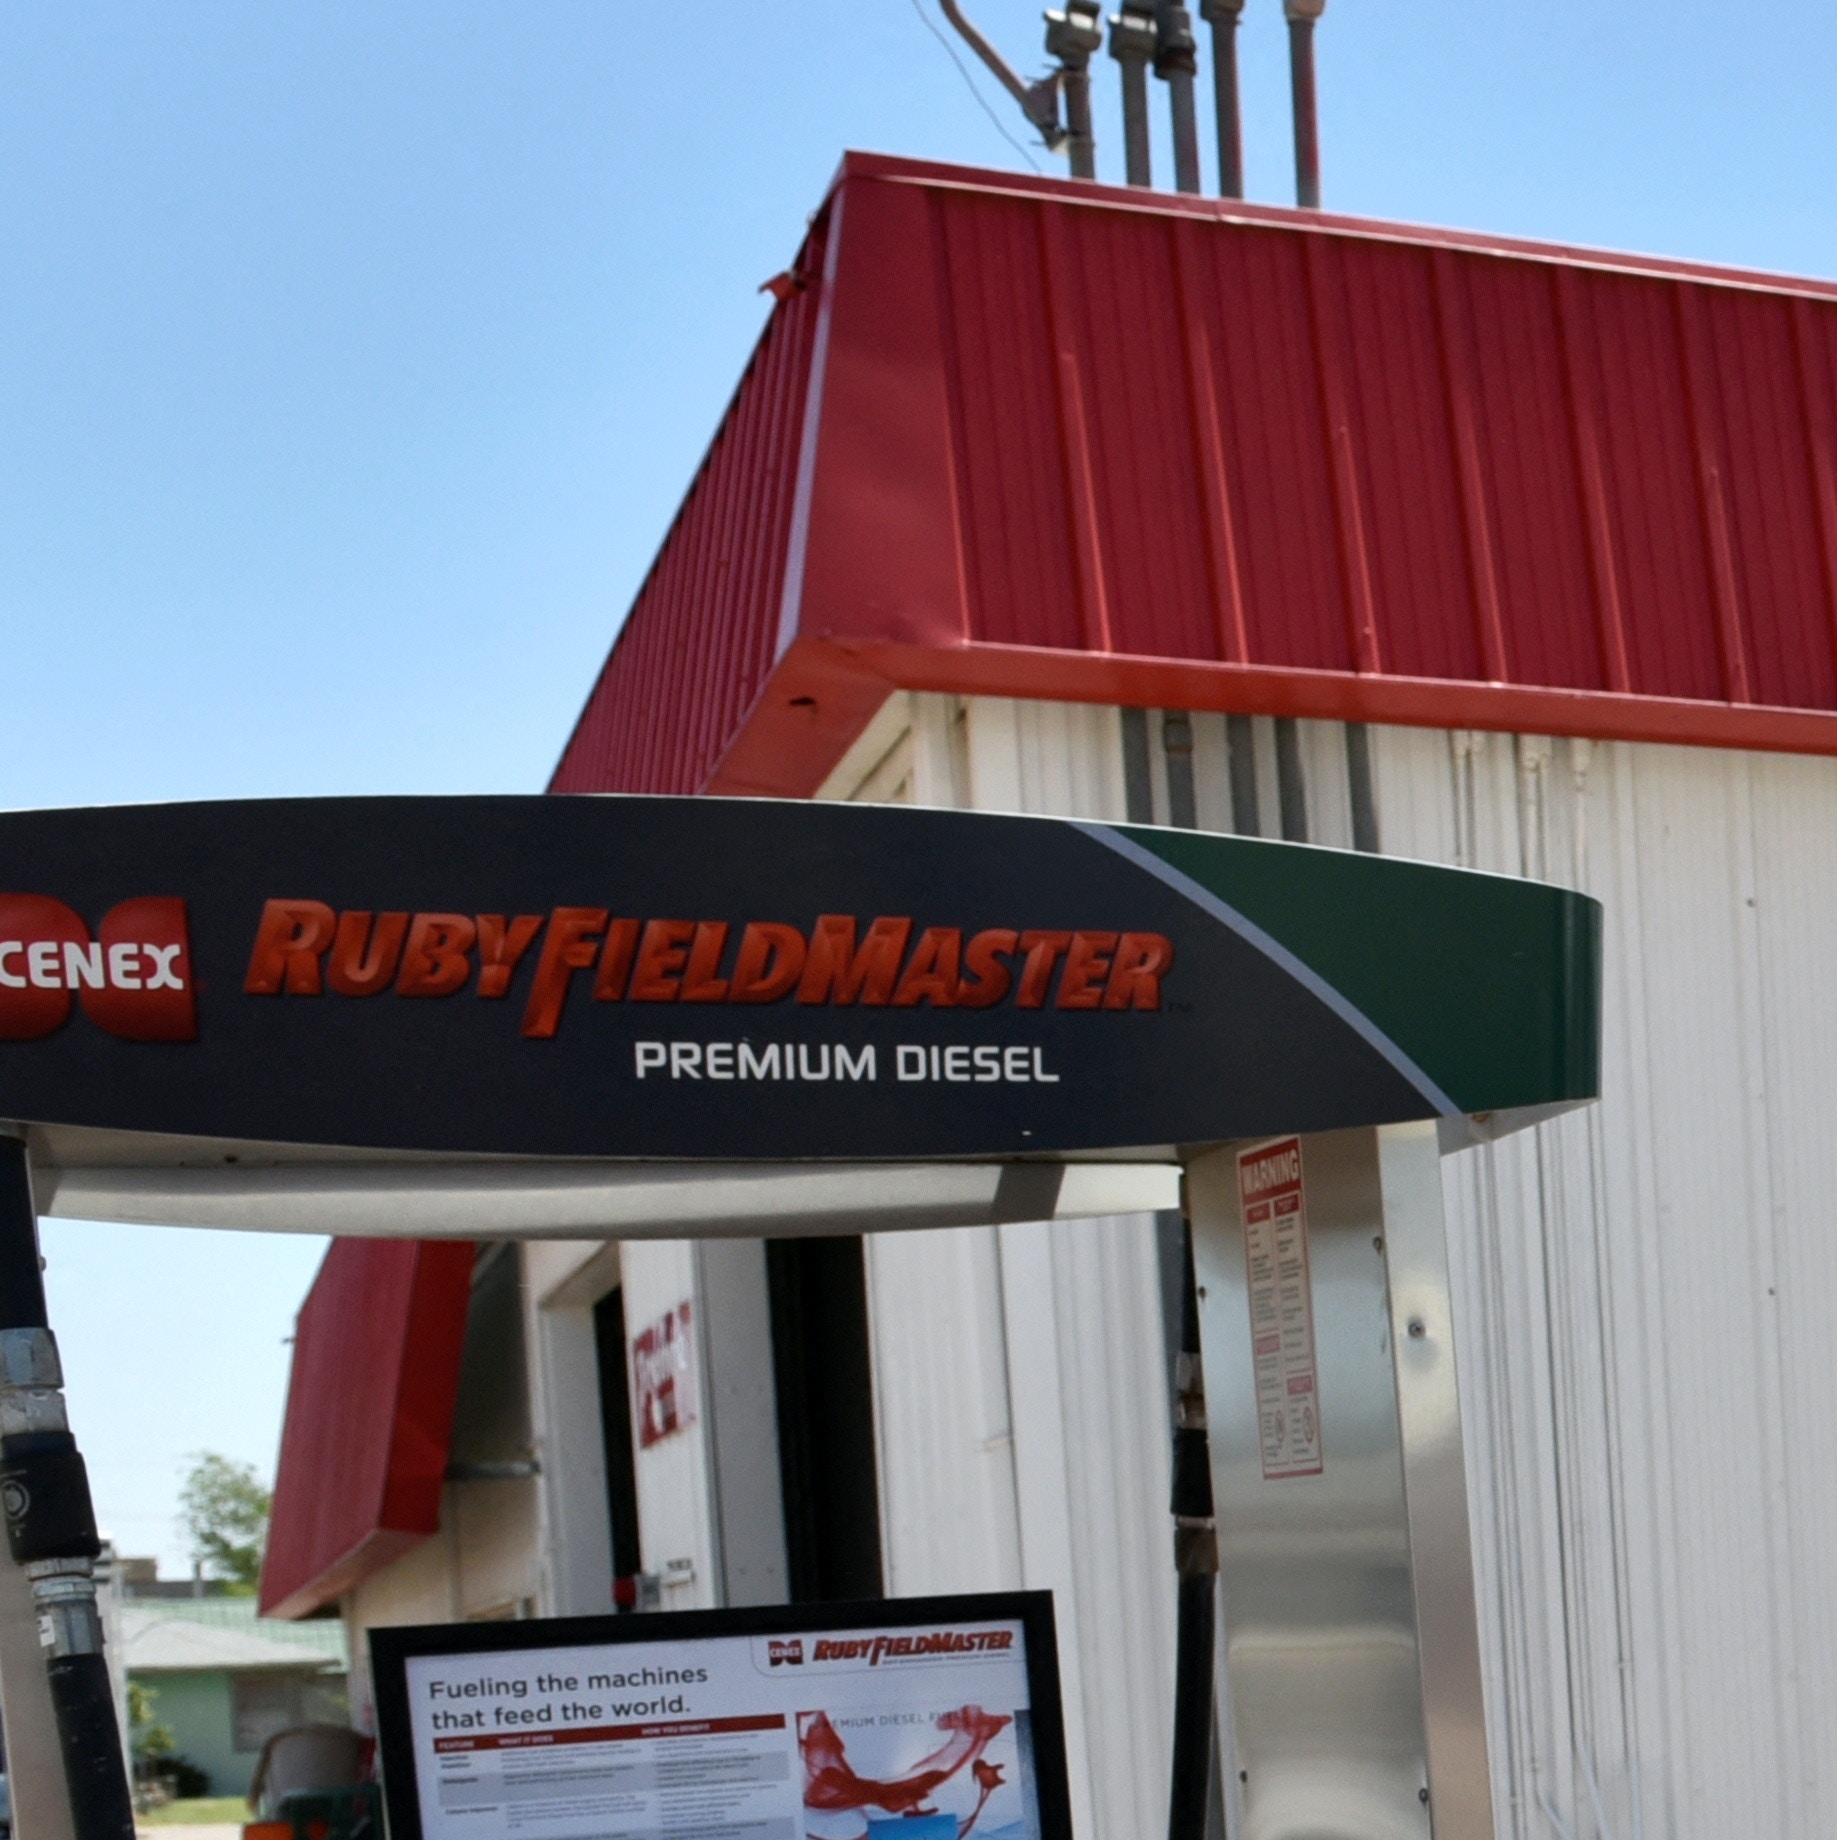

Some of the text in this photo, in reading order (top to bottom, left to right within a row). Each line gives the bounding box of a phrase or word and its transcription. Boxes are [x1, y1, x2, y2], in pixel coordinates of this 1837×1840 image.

[0, 940, 184, 990] CENEX
[634, 1041, 1060, 1083] PREMIUM DIESEL
[1241, 1148, 1299, 1195] WARNING
[429, 1666, 708, 1699] Fueling the machines
[432, 1694, 692, 1730] that feed the world.
[879, 1714, 924, 1727] DIESEL
